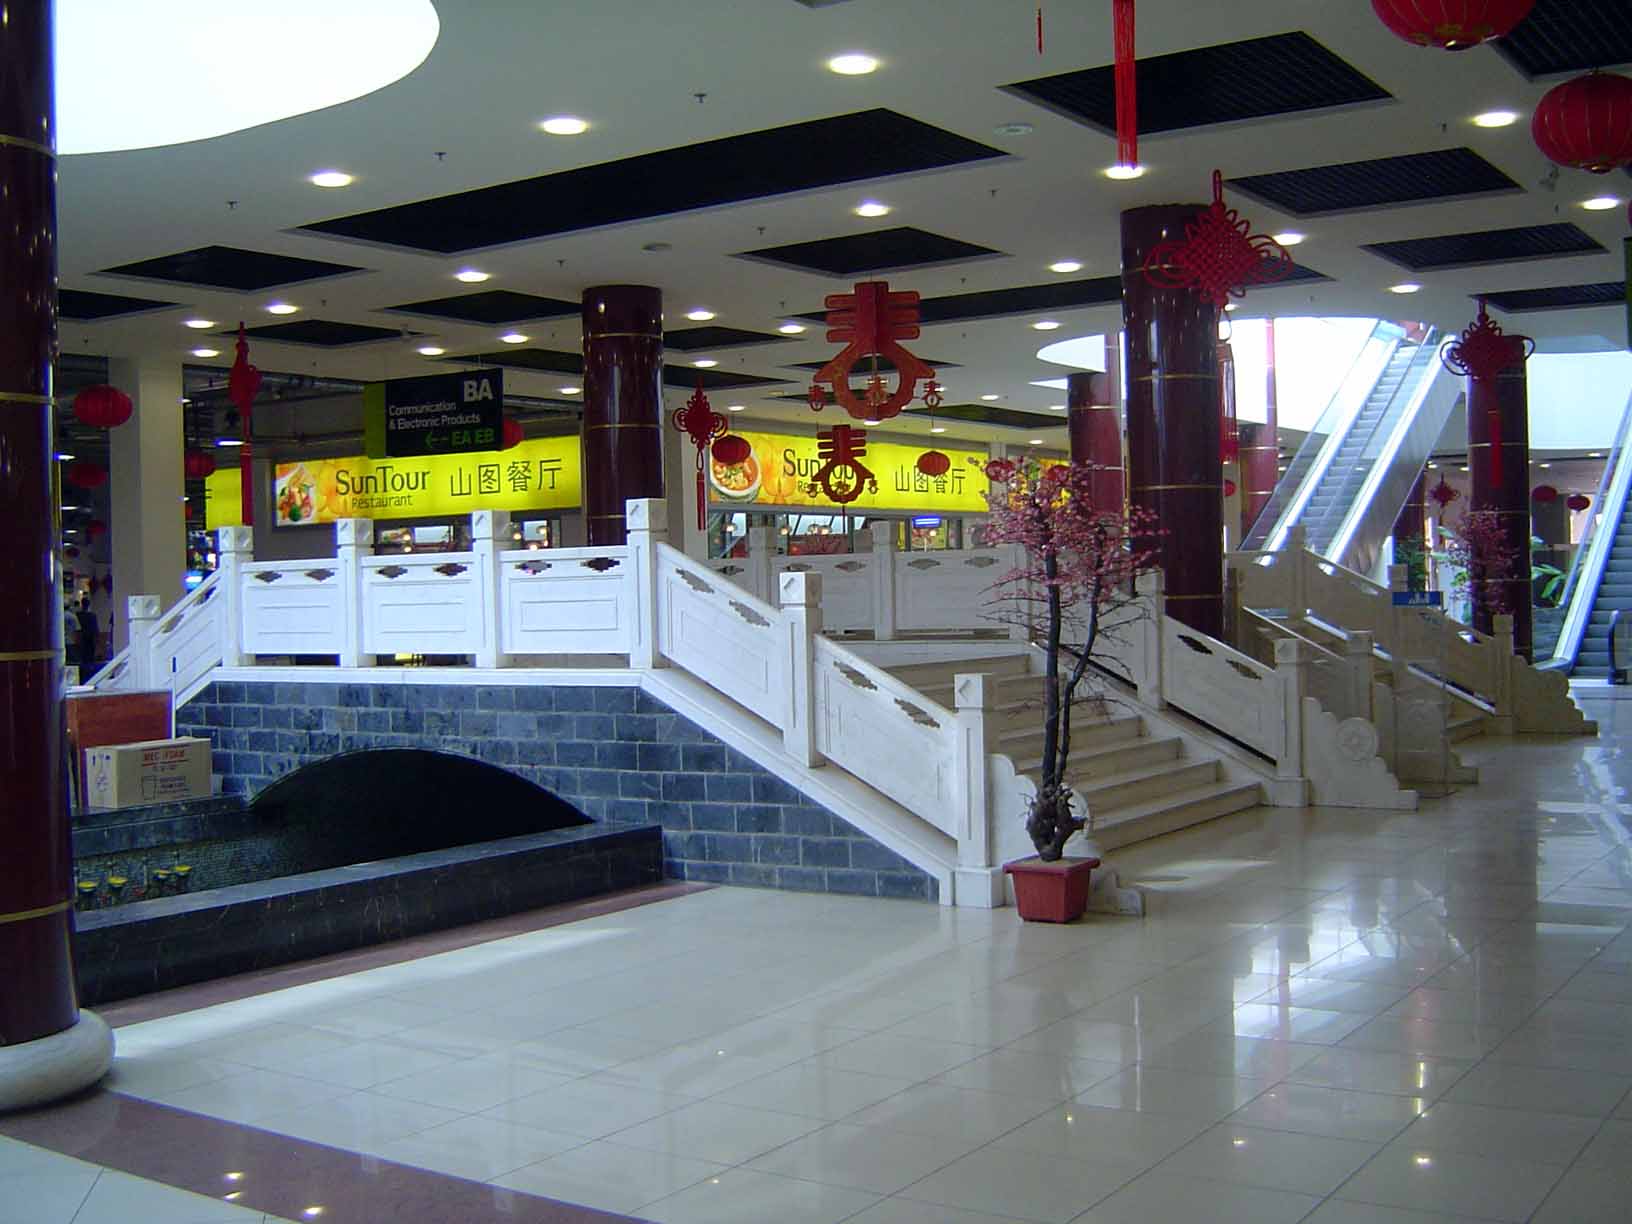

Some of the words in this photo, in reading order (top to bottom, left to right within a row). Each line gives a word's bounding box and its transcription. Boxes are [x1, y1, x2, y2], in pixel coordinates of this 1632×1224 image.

[463, 378, 494, 402] BA
[388, 399, 457, 417] Communication
[397, 416, 441, 431] Electronic
[440, 412, 481, 426] Products
[451, 430, 472, 448] EA
[335, 465, 431, 496] SunTour
[450, 458, 562, 497] 山图餐厅
[351, 494, 414, 509] Restaurant
